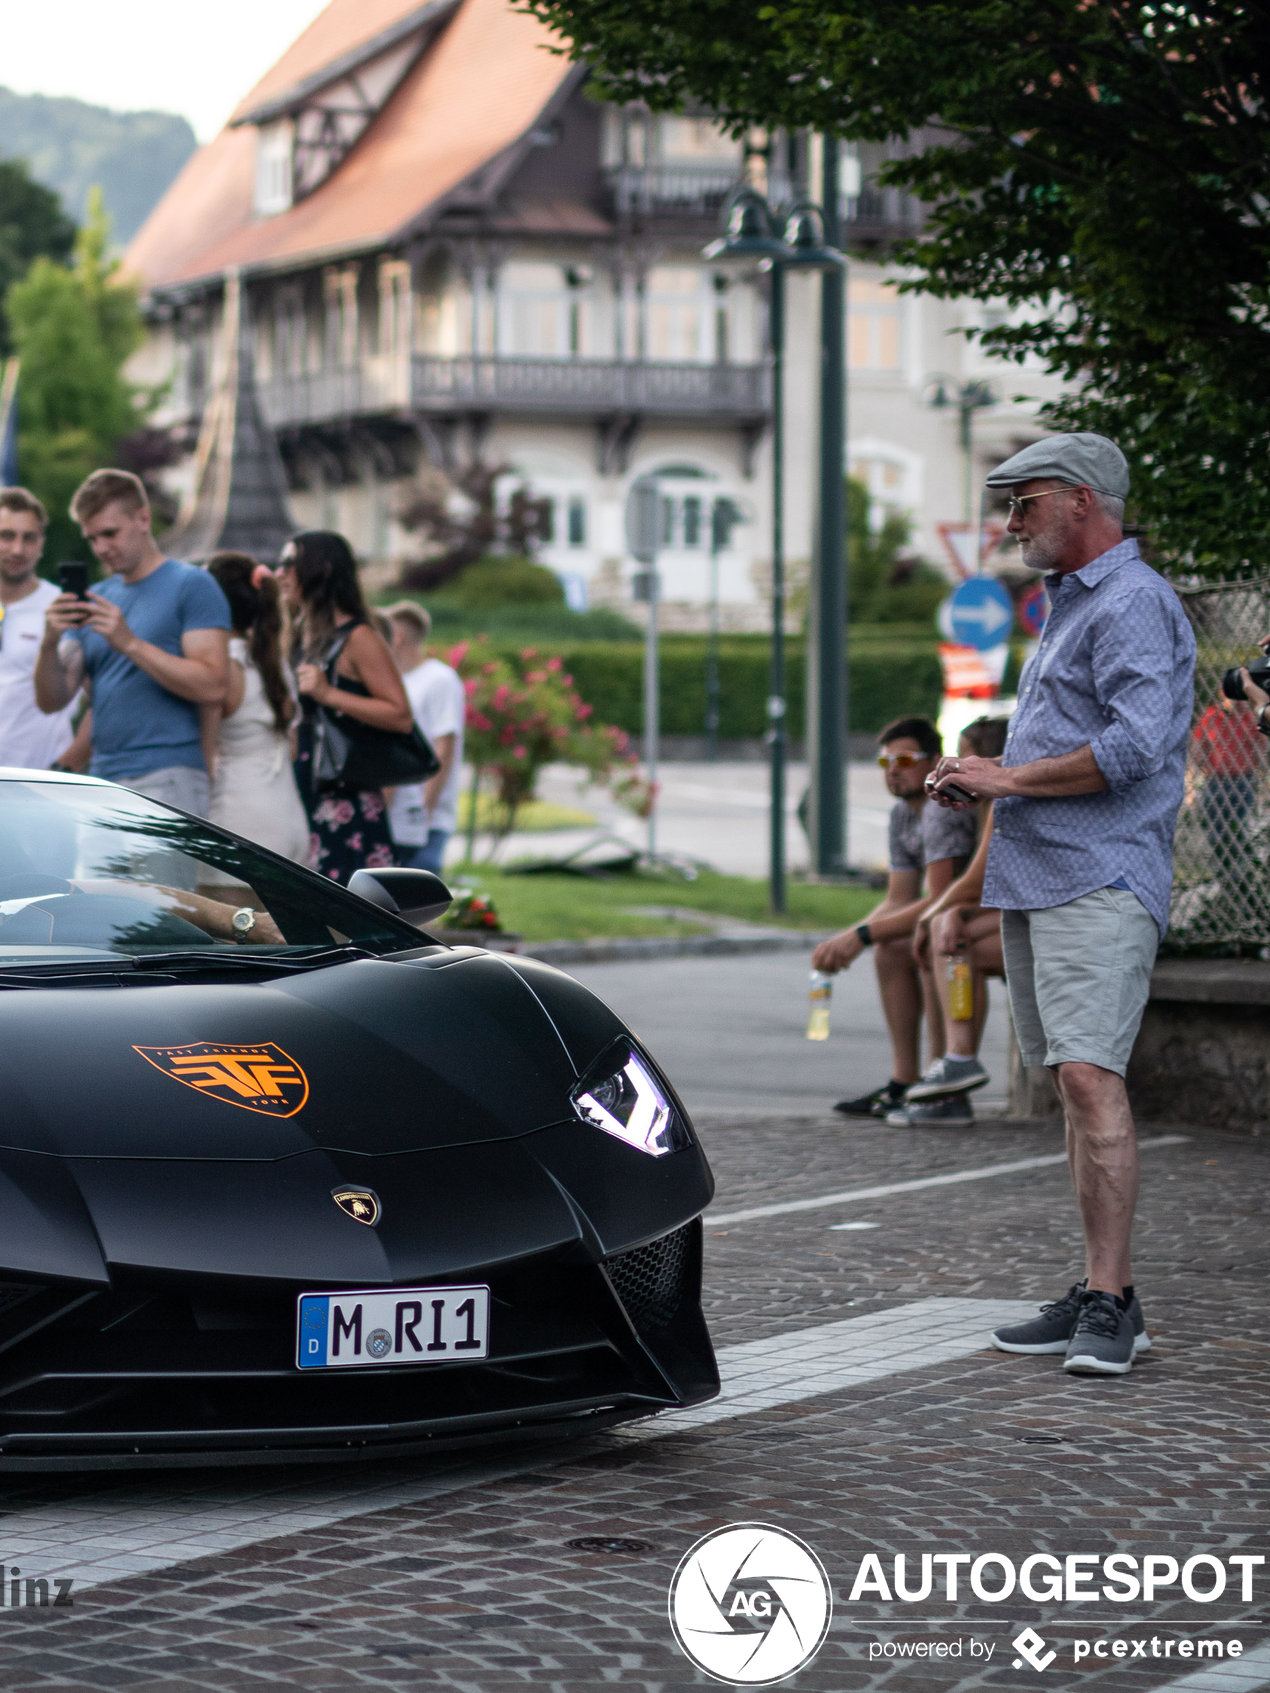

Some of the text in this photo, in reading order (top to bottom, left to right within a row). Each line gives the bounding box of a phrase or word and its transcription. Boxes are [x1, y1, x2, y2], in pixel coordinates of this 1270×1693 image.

[156, 1049, 193, 1057] FAST
[332, 1303, 363, 1357] M
[394, 1298, 481, 1353] RI1
[308, 1338, 319, 1354] D
